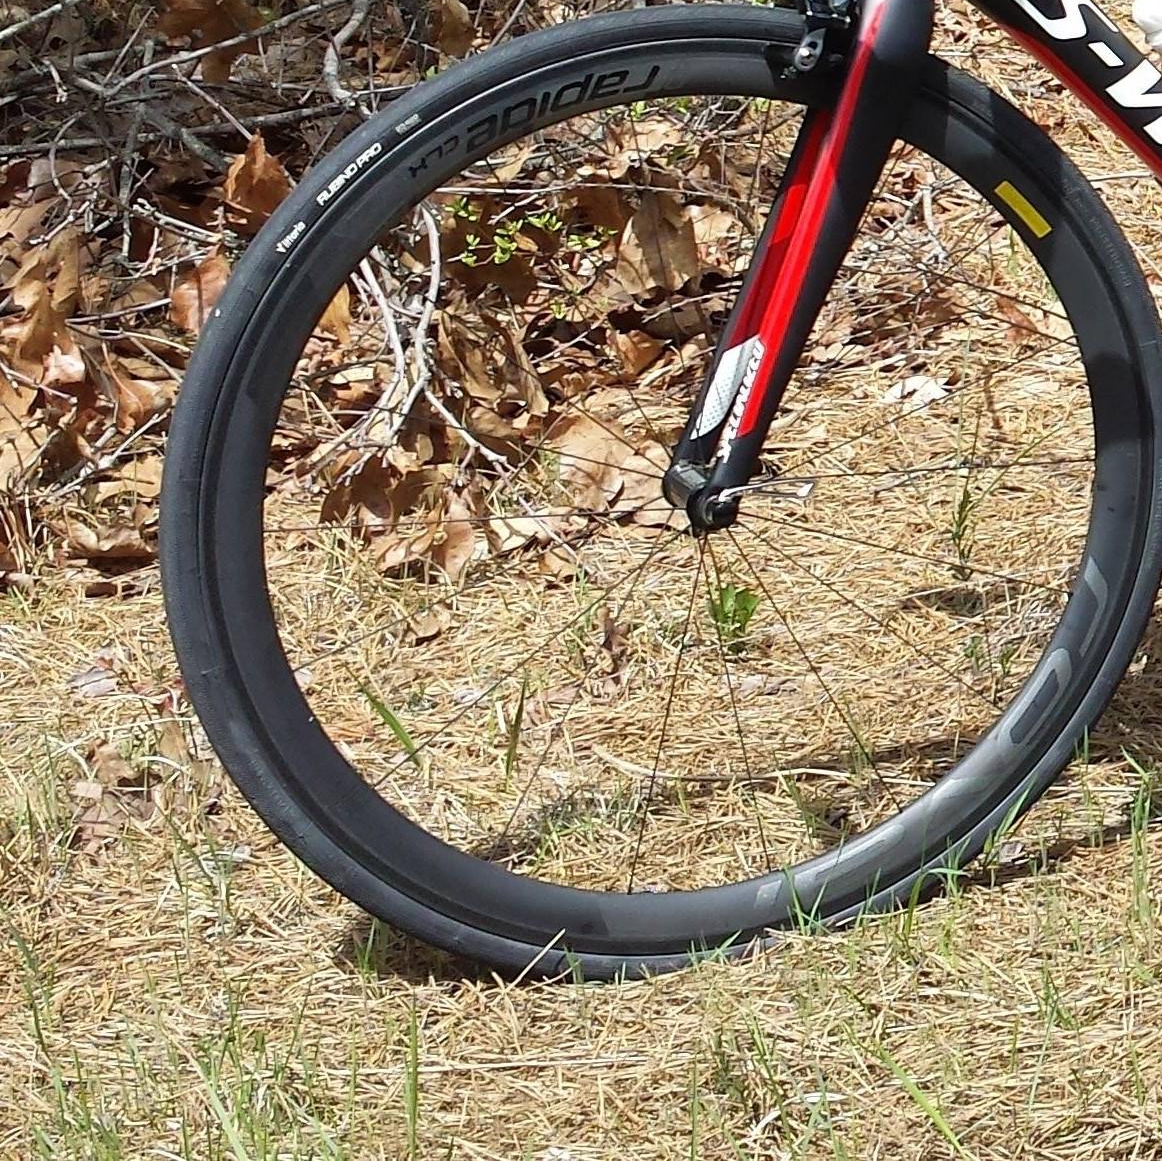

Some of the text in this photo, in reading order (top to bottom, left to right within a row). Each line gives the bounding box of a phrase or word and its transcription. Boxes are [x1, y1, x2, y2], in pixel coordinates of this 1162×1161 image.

[466, 64, 660, 154] rapide
[316, 142, 382, 207] RUBINO PRO
